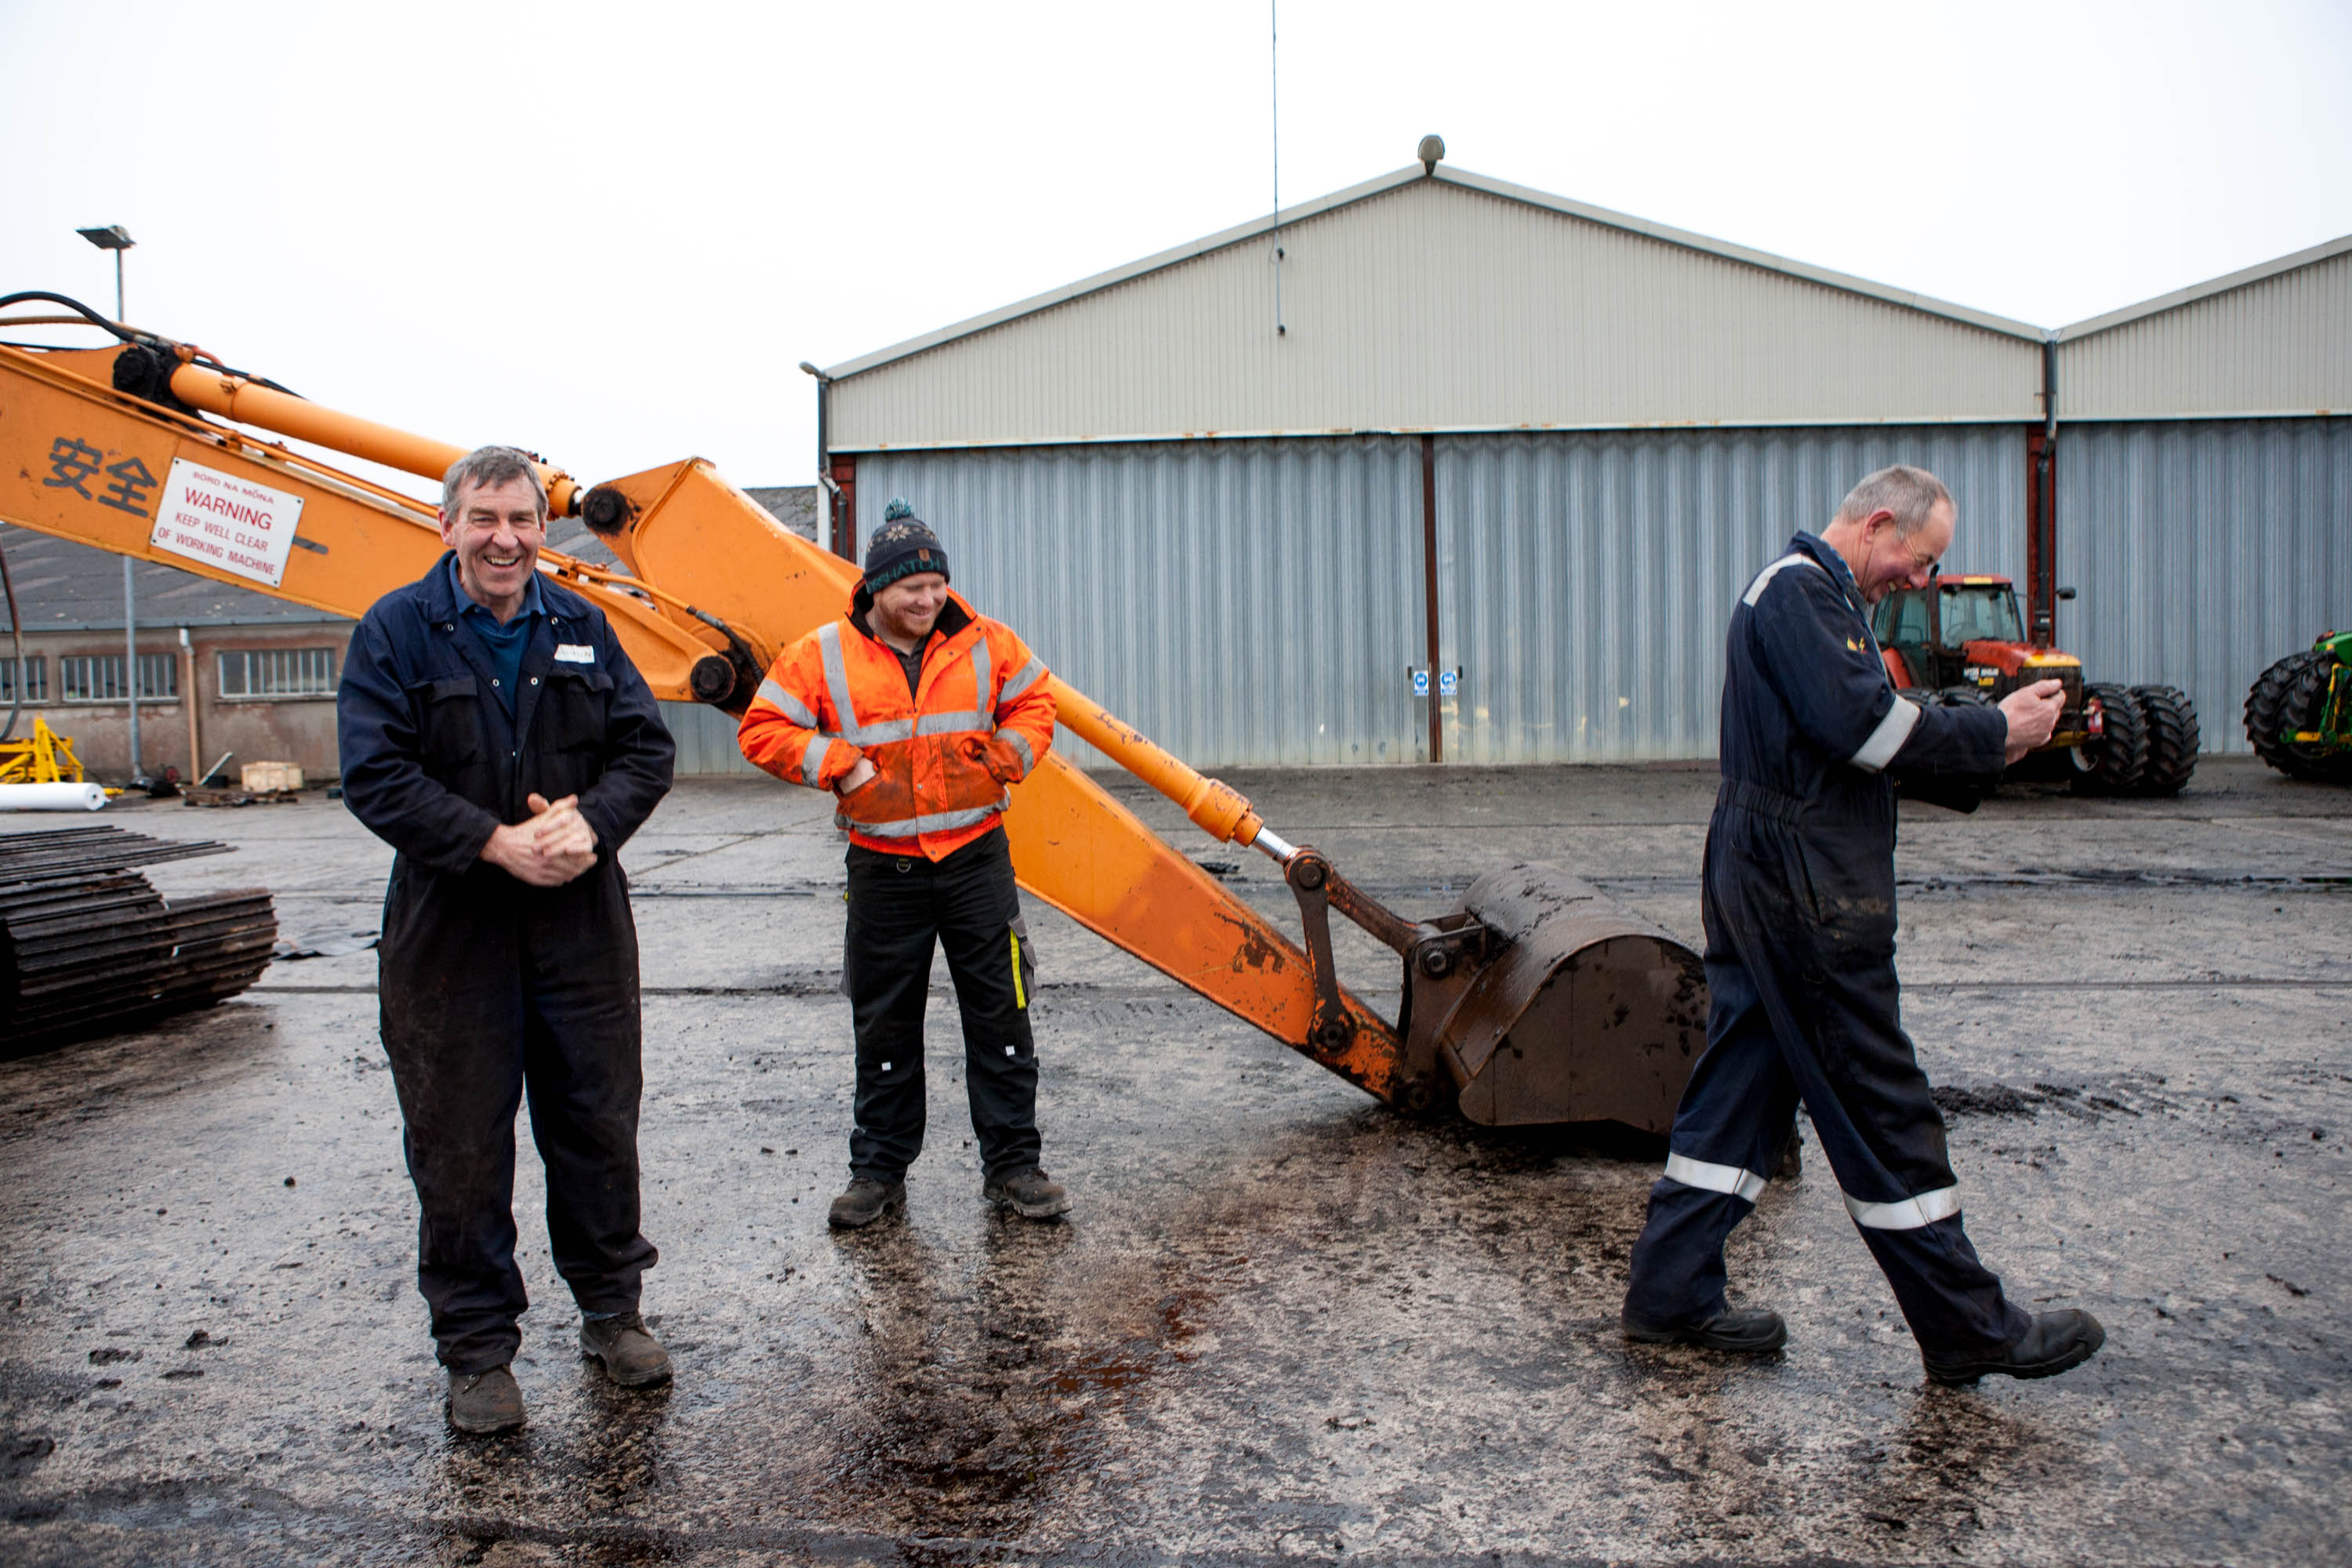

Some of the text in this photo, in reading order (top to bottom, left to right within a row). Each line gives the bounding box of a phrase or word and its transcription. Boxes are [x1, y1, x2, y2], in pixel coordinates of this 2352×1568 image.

[42, 437, 158, 518] 安全
[193, 471, 220, 486] BORD
[223, 482, 239, 492] NA
[185, 487, 273, 531] WARNING
[158, 527, 276, 575] OF WORKING MACHINE
[175, 512, 268, 552] KEEP WELL CLEAR
